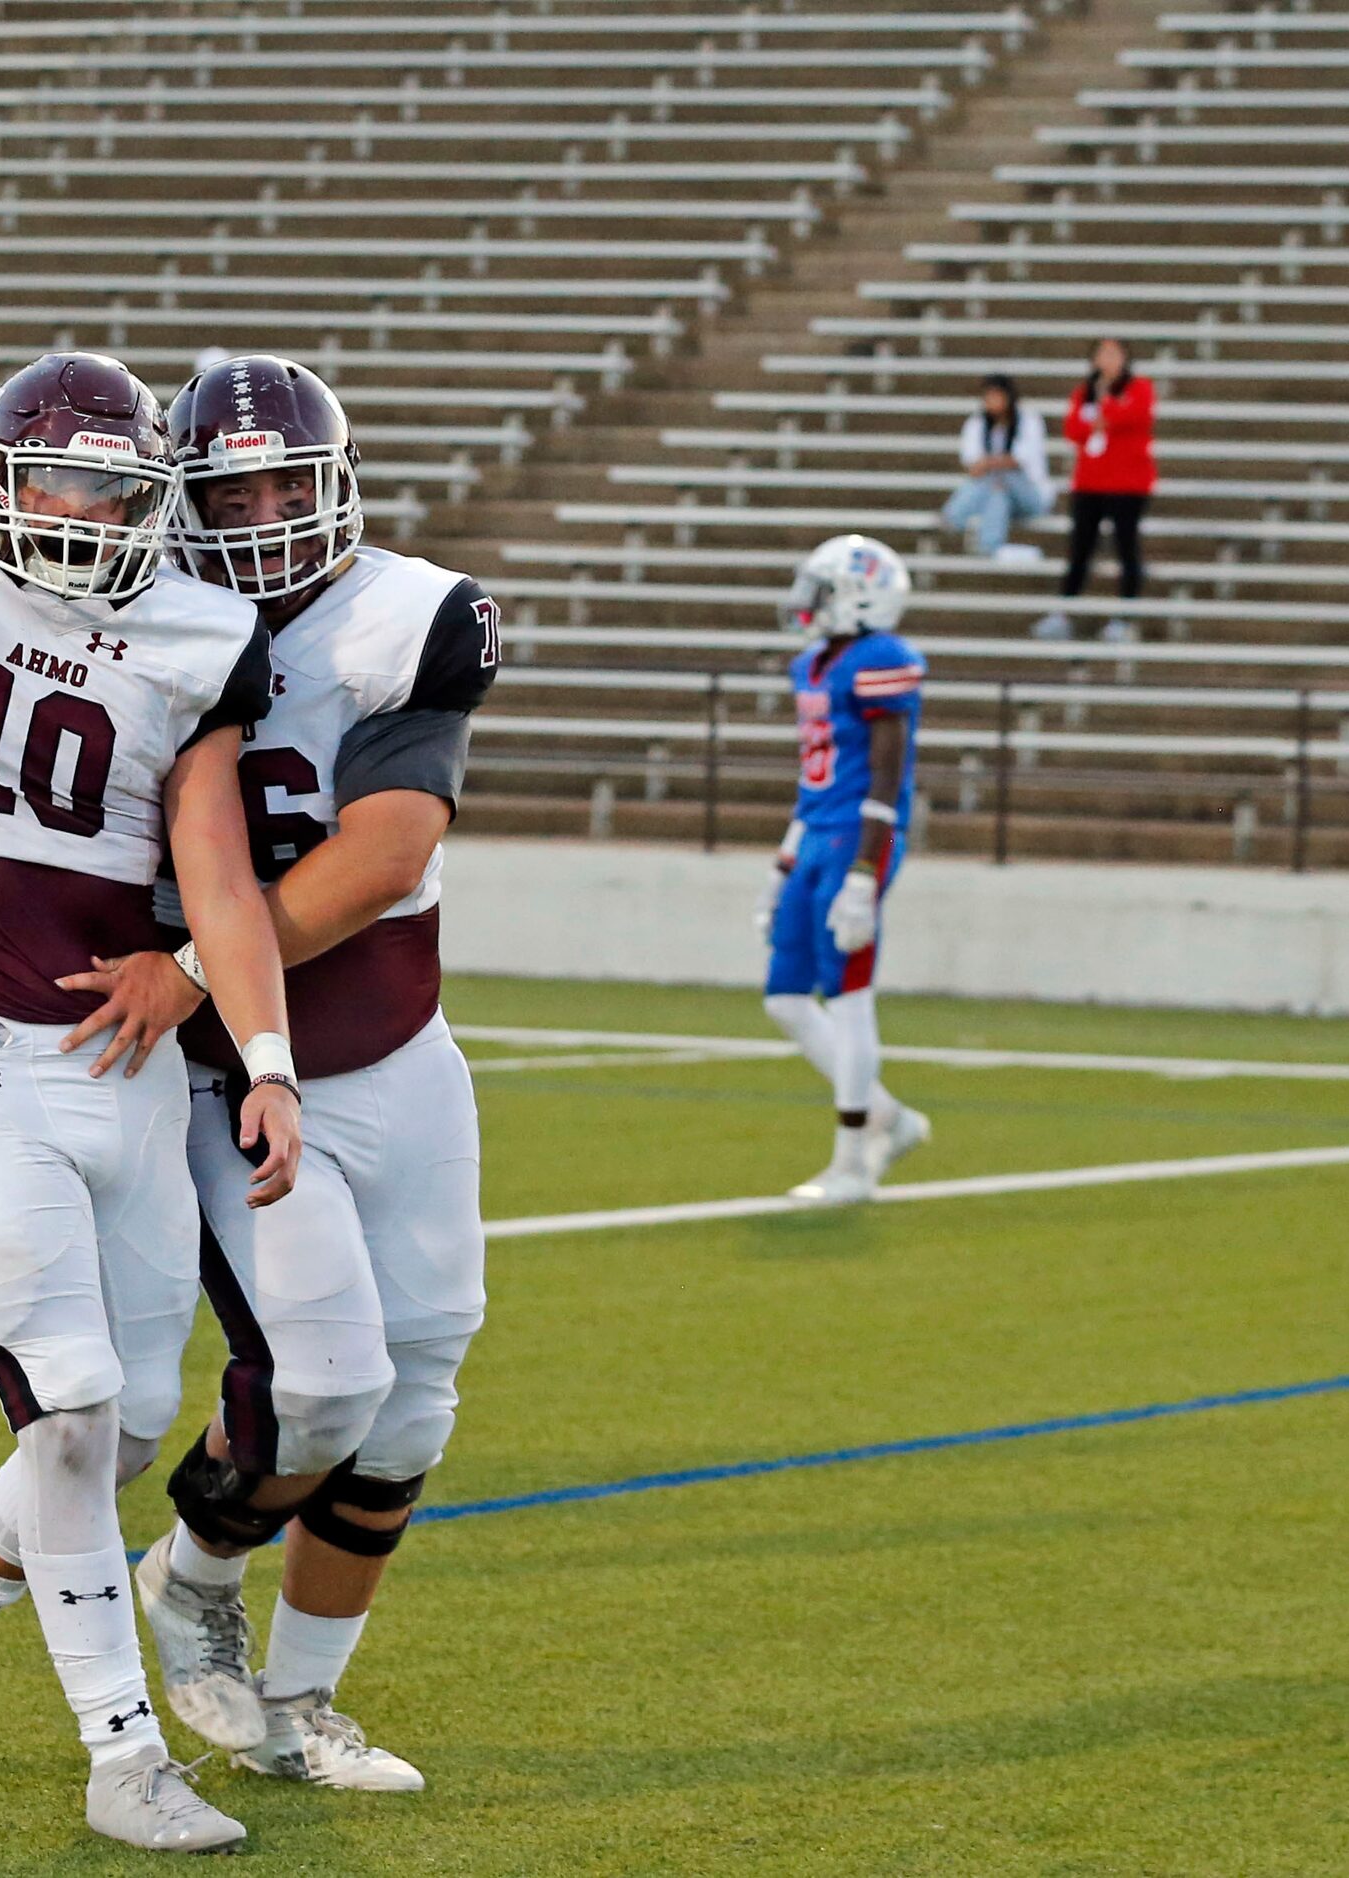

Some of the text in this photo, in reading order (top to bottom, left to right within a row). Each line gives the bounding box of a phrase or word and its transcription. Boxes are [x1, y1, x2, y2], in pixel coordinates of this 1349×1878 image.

[79, 434, 131, 451] Riddell
[225, 434, 267, 450] Riddell
[6, 642, 89, 688] AHMO
